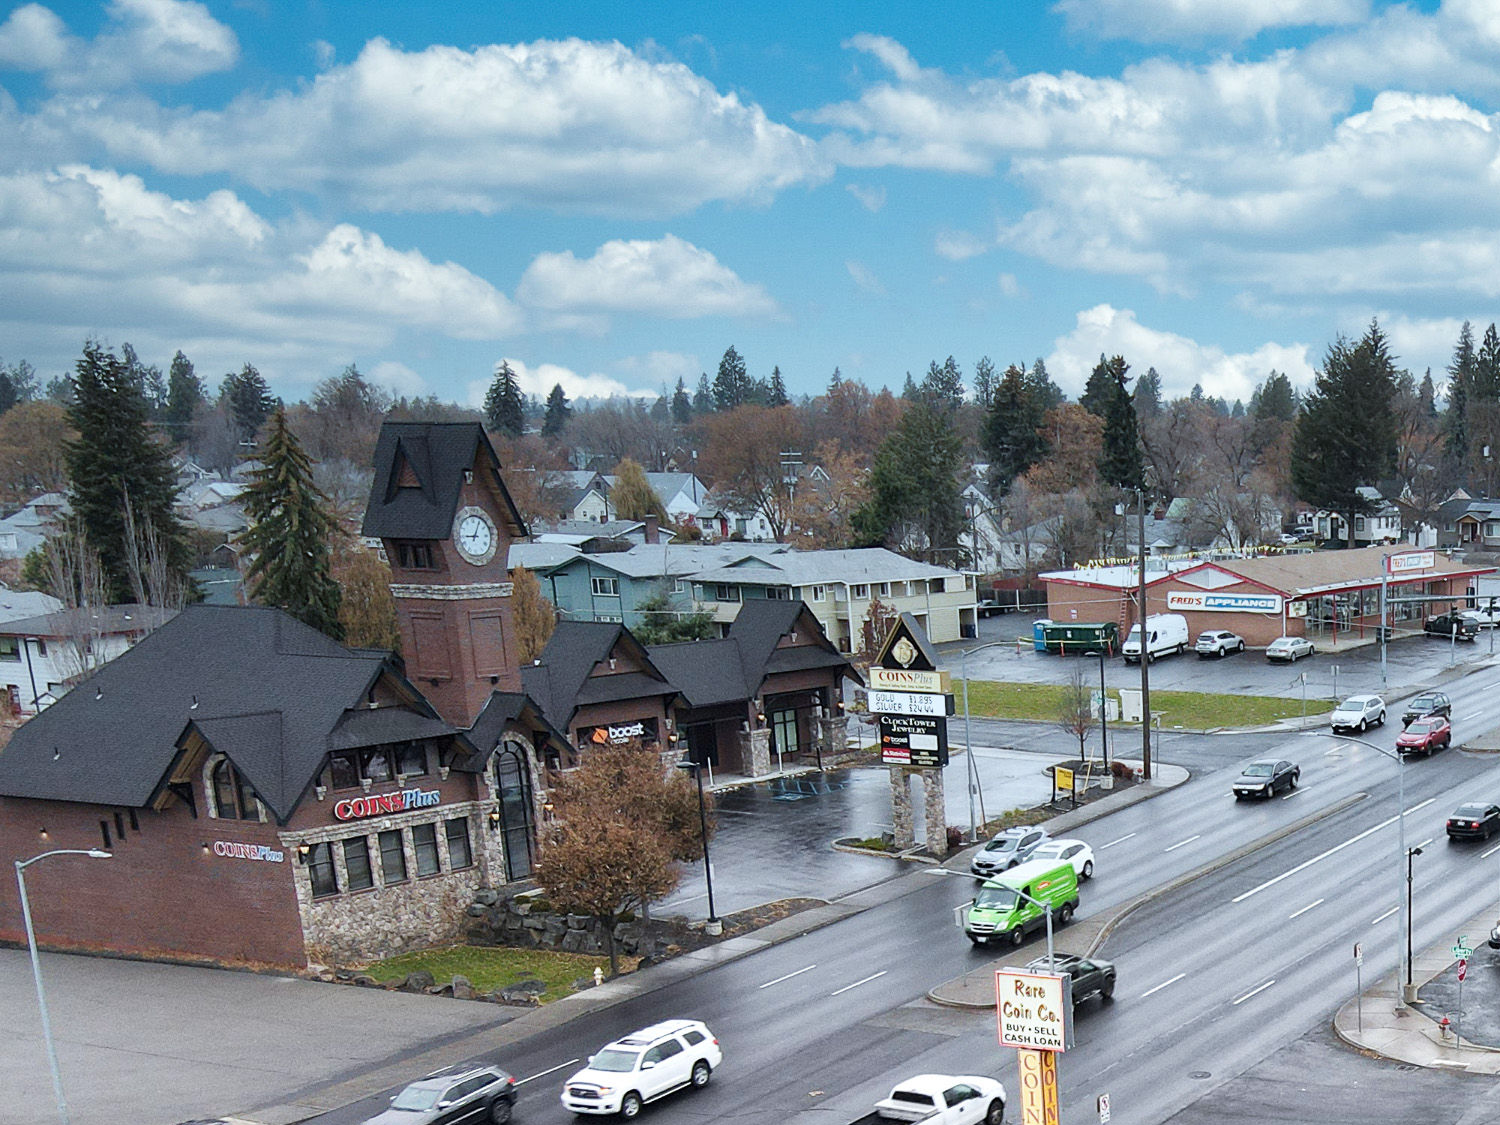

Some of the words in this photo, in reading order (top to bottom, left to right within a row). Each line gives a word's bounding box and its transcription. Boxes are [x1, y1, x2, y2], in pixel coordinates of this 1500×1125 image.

[1170, 596, 1202, 606] FRED'S
[1206, 598, 1275, 608] APPLIANCE
[875, 693, 895, 703] GOLD
[875, 702, 902, 712] SILVER
[608, 722, 645, 739] boost
[1014, 979, 1046, 999] Rare
[1002, 1001, 1032, 1020] Coin
[1037, 1004, 1061, 1023] Co.
[1006, 1023, 1026, 1033] BUY
[1034, 1026, 1059, 1037] SELL
[1004, 1033, 1032, 1044] CASH
[1034, 1036, 1061, 1047] LOAN
